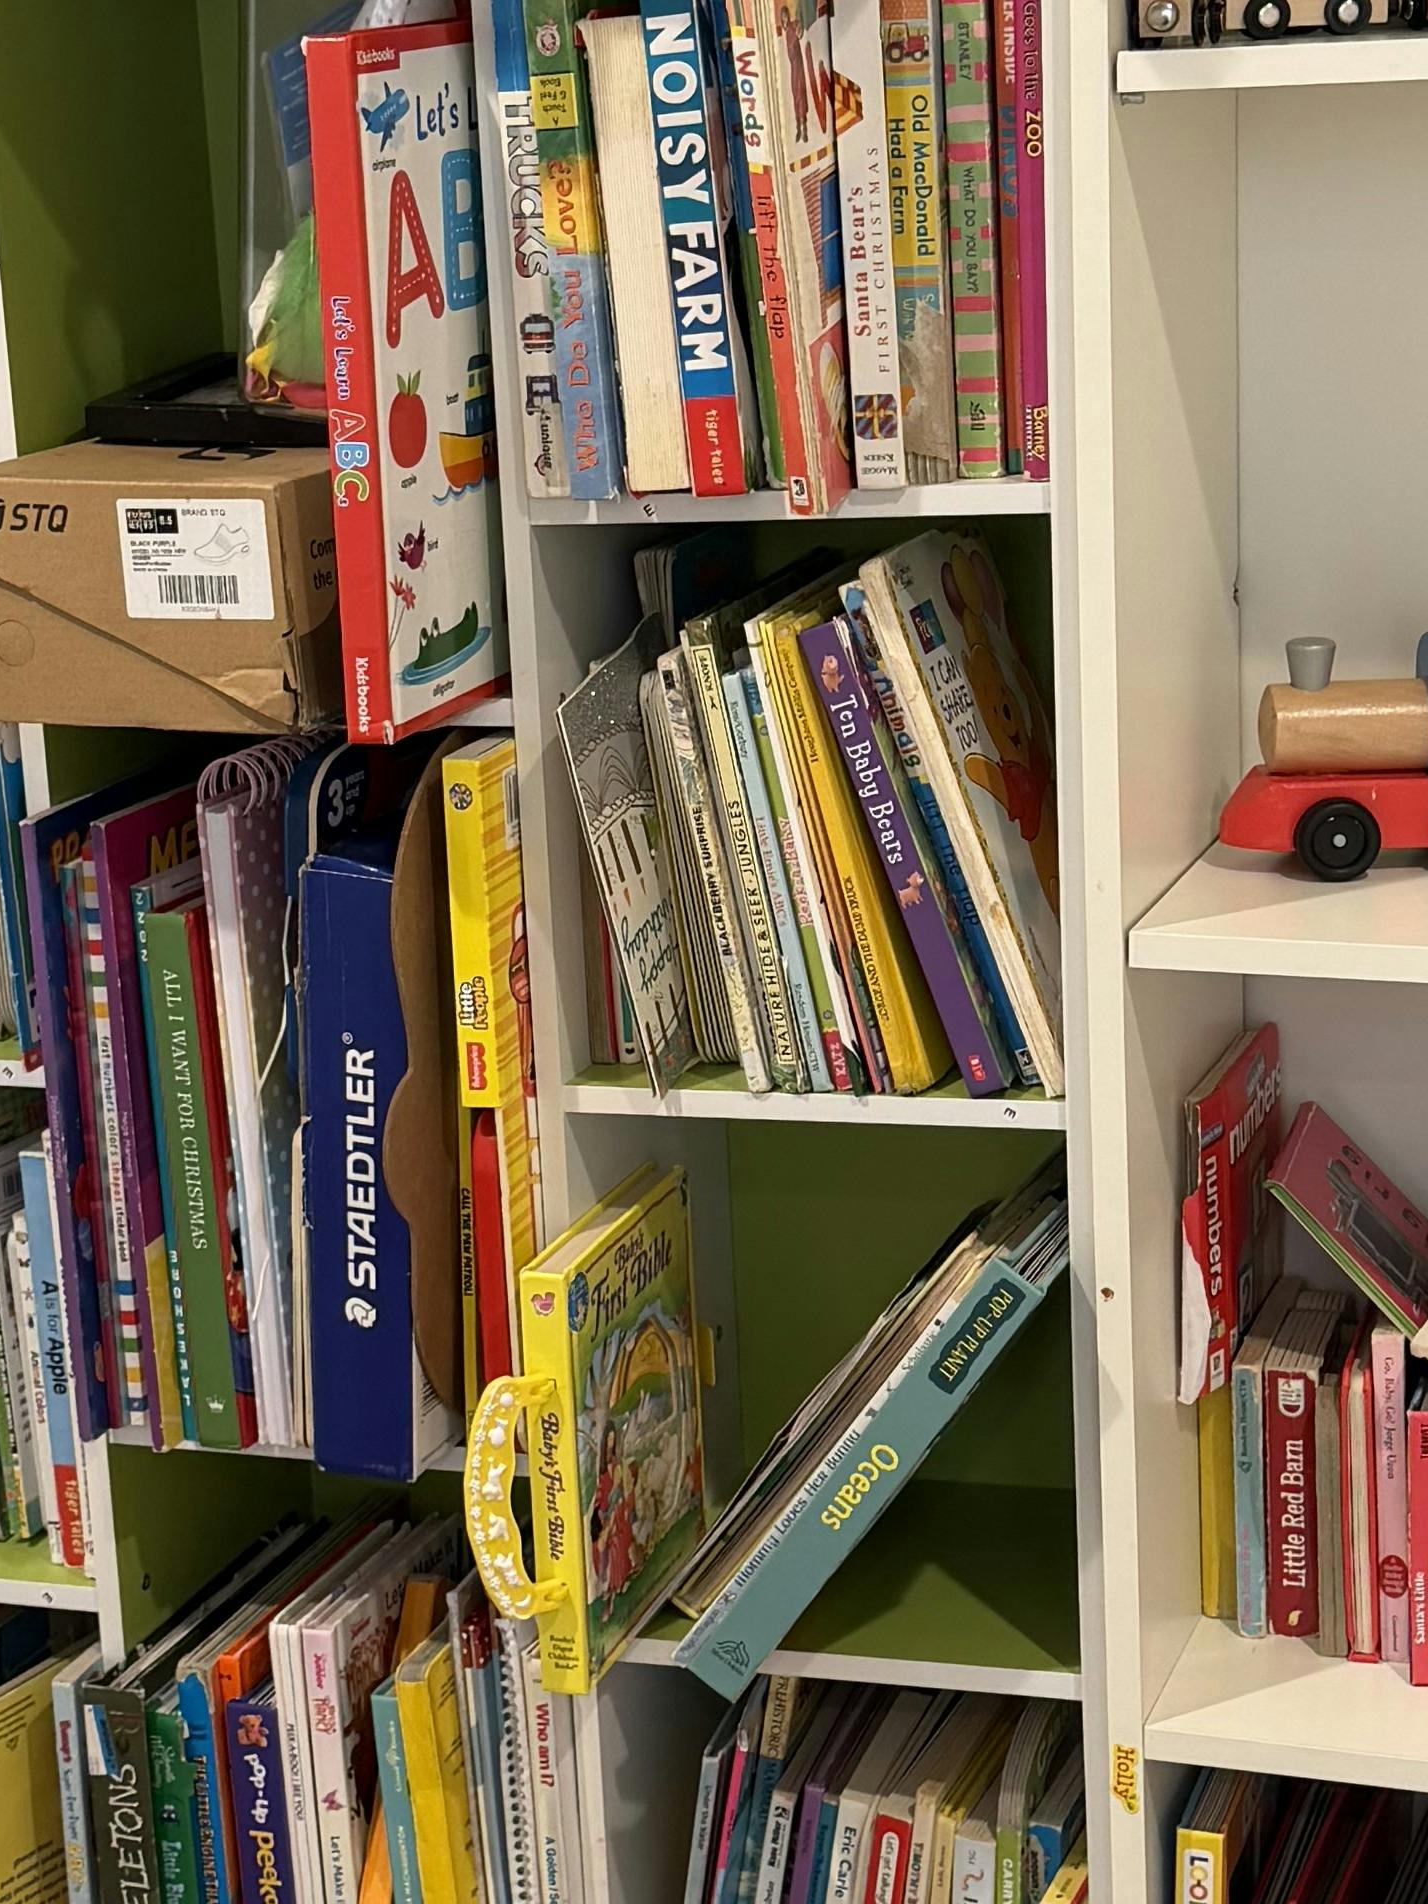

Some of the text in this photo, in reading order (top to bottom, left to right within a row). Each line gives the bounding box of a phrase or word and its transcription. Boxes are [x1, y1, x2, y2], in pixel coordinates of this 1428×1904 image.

[738, 51, 763, 147] Words
[958, 22, 973, 81] STANLEY
[504, 97, 549, 278] TRUCKS
[645, 15, 726, 371] NOISY FARM
[889, 118, 909, 235] Had a Farm
[911, 95, 935, 257] Old MacDonald
[755, 195, 788, 339] lift the flap
[847, 187, 871, 337] Santa Bear's
[867, 148, 890, 374] FIRST CHRISTMAS
[703, 409, 726, 484] tiger tales
[10, 503, 68, 533] STQ
[355, 656, 371, 734] Kidsbooks
[875, 678, 920, 768] Animals
[726, 800, 754, 874] JUNGLES
[828, 695, 905, 865] Ten Baby Bears
[162, 970, 208, 1250] ALL I WANT FOR CHRISTMAS
[346, 1050, 376, 1290] STAEDTLER
[1203, 1154, 1226, 1296] numbers
[30, 1351, 47, 1424] Animal Colors
[41, 1280, 70, 1396] A is for Apple
[938, 1289, 1014, 1382] POP-UP PLANET
[539, 1412, 565, 1561] Baby's First Bible
[820, 1444, 900, 1532] Oceans
[1278, 1439, 1306, 1587] Little Red Barn
[243, 1753, 272, 1824] pop-up
[535, 1703, 554, 1788] Who am I?
[834, 1825, 857, 1899] Eric Carle
